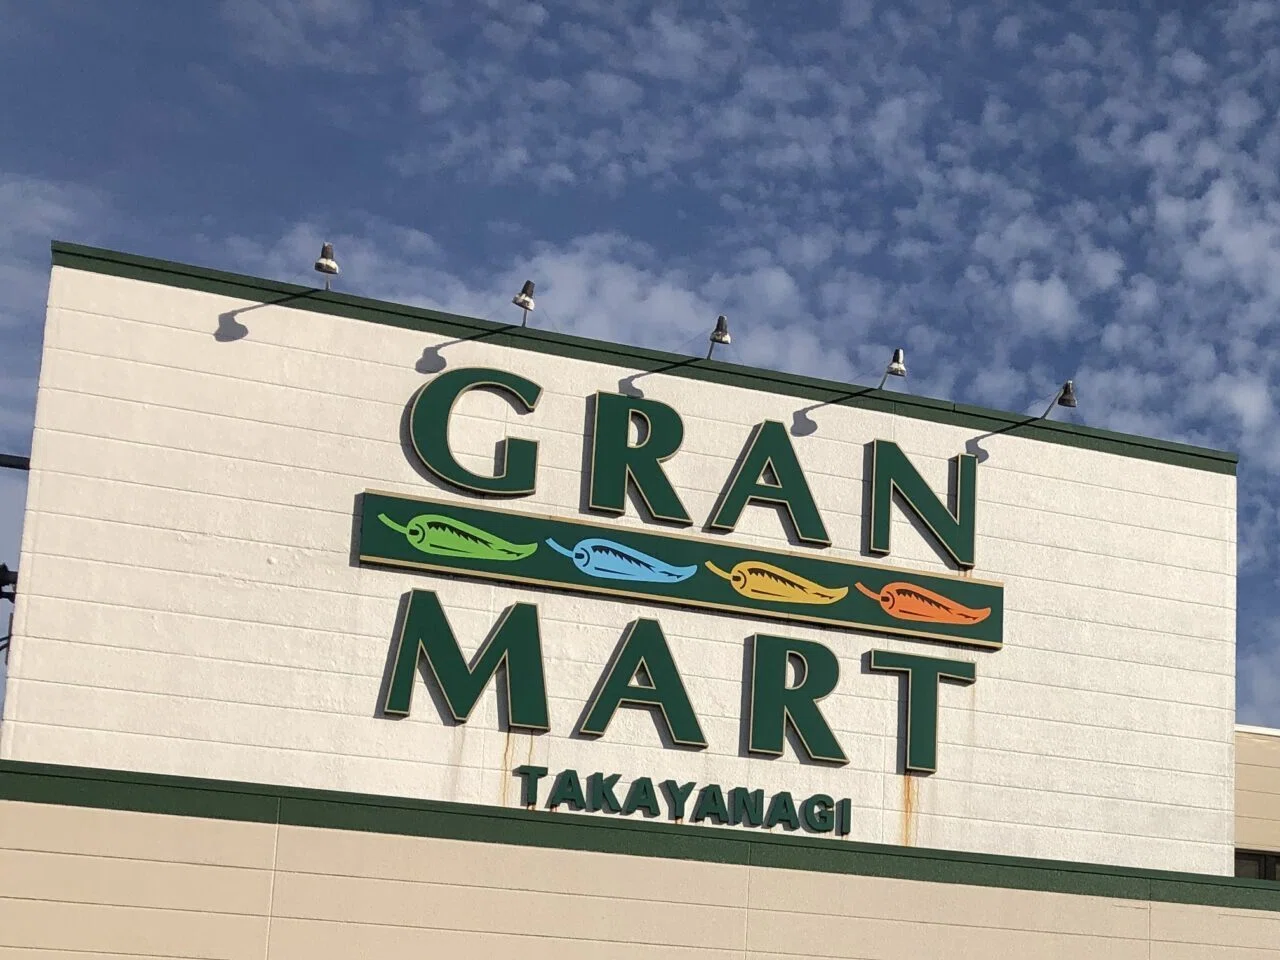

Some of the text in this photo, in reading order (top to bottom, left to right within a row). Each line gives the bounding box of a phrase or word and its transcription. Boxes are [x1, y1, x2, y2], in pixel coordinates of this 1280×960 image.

[404, 366, 978, 569] GRAN
[382, 587, 977, 774] MART
[514, 764, 852, 836] TAKAYANAGI
